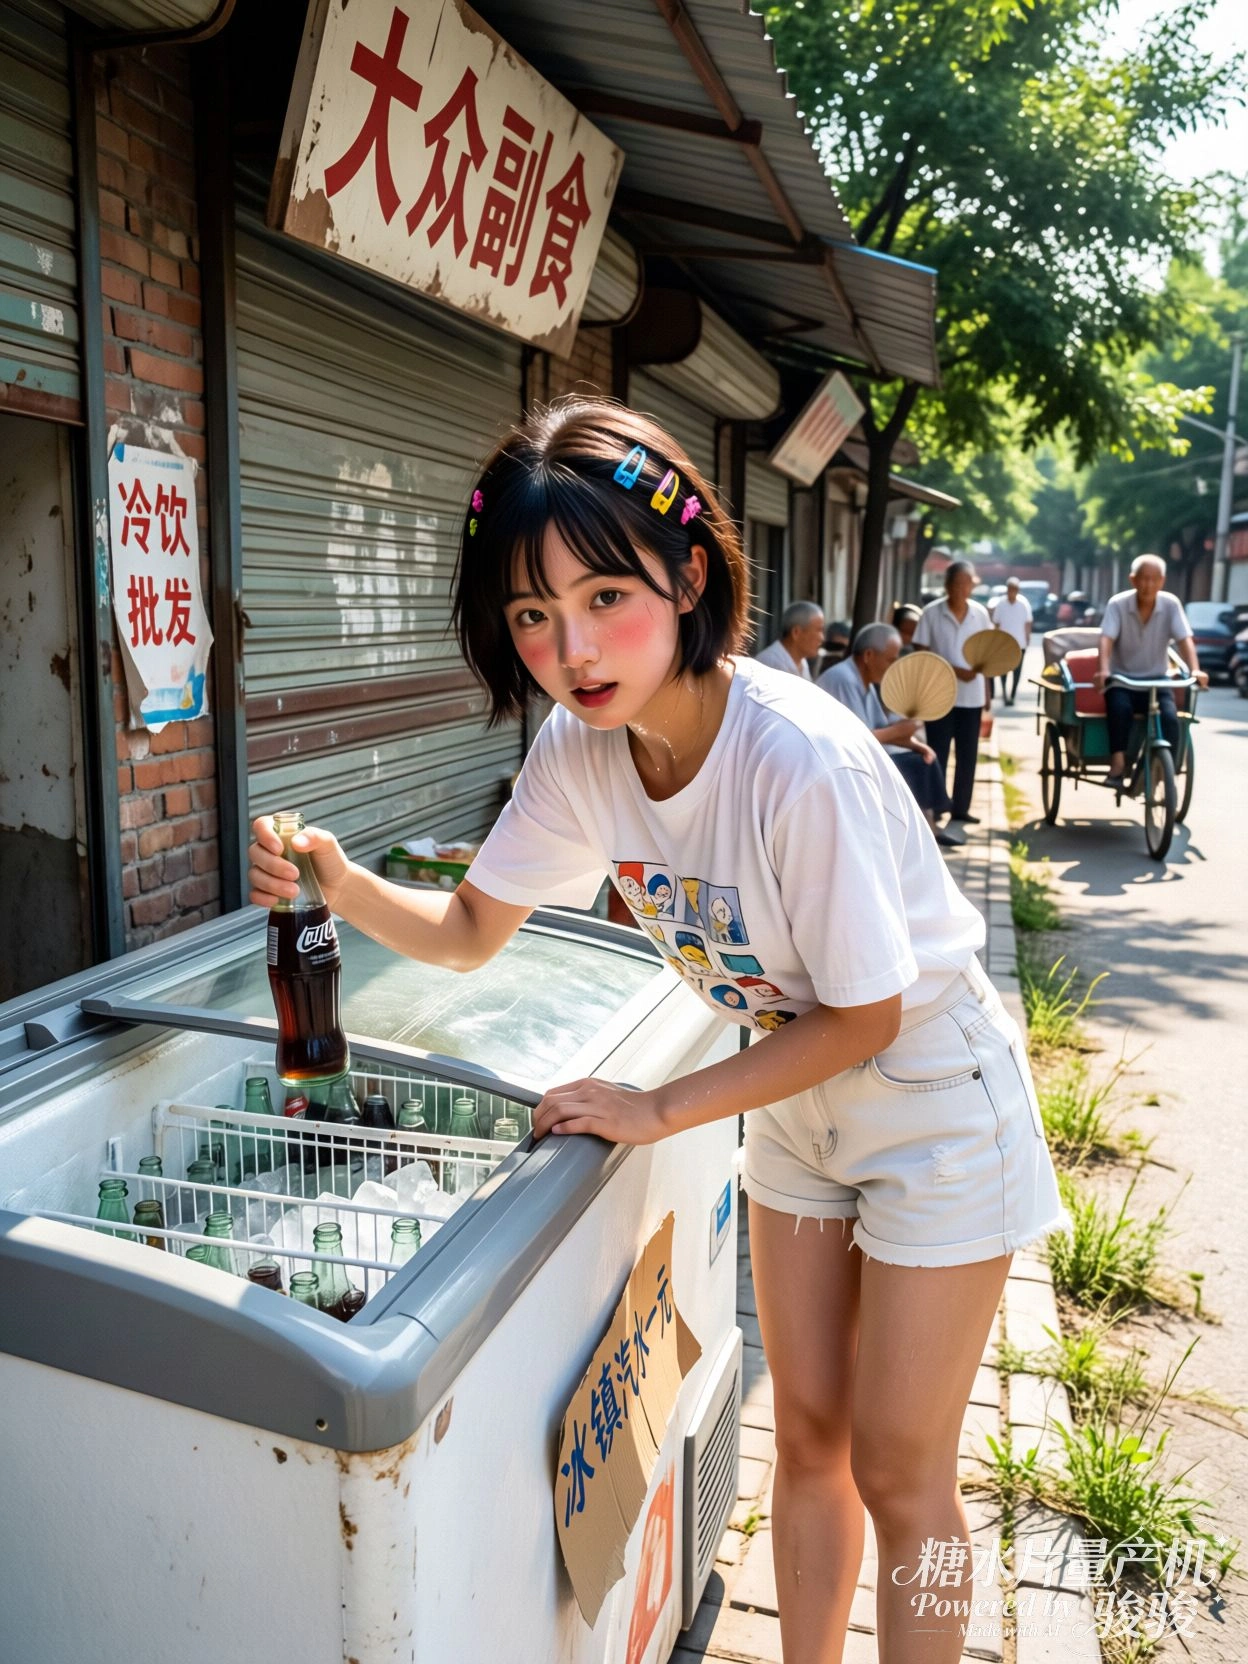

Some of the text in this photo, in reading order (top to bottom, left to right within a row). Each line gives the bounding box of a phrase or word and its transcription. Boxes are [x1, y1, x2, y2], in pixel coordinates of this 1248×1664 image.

[324, 5, 592, 310] 大众副食
[117, 477, 191, 557] 冷饮
[127, 574, 197, 648] 批发
[561, 1263, 672, 1528] 冰镇汽水一元
